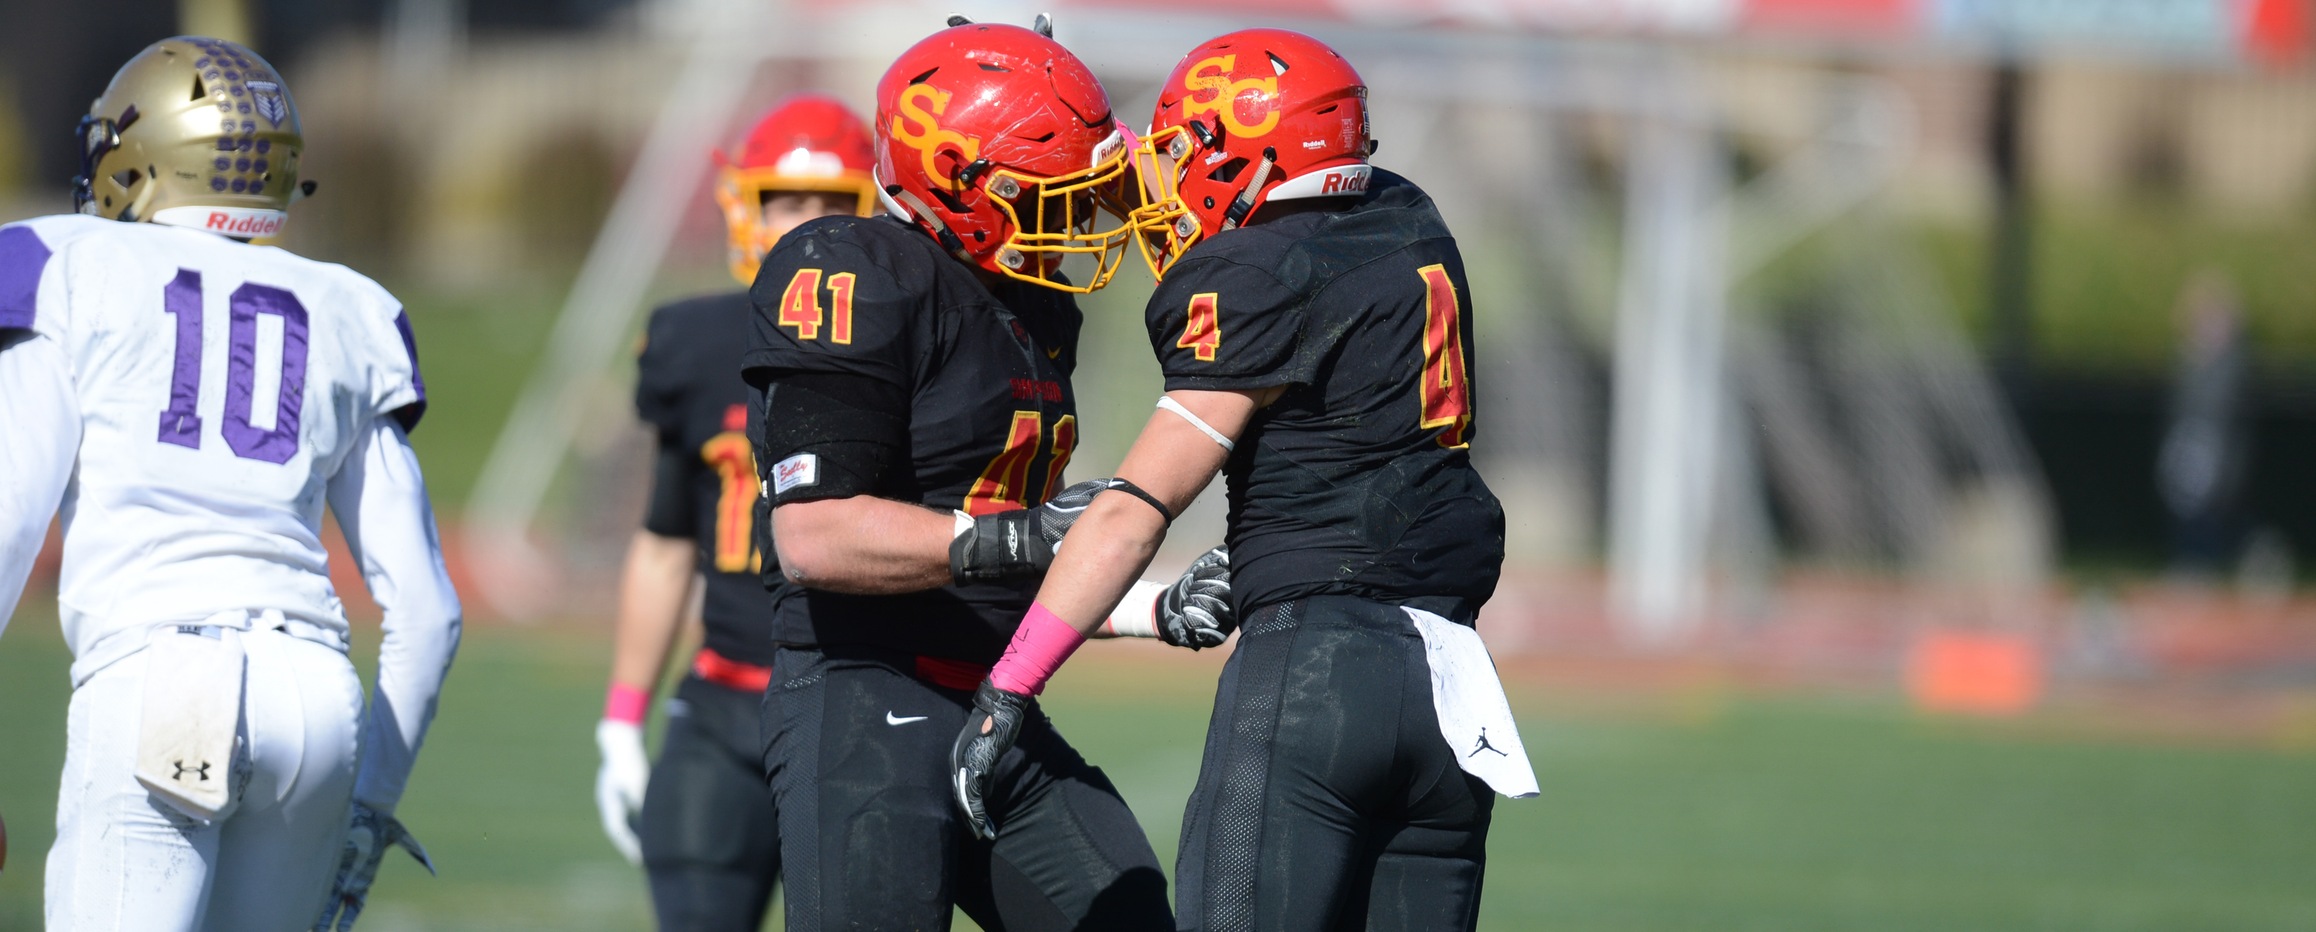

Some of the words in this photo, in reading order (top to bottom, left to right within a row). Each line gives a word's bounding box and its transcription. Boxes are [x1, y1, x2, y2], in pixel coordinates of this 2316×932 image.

[892, 83, 981, 191] SC
[1183, 54, 1281, 138] SC
[206, 212, 286, 233] Riddel
[1322, 170, 1371, 194] Ridde
[779, 268, 856, 345] 41
[1176, 292, 1221, 361] 4
[158, 267, 309, 465] 10
[1417, 263, 1471, 449] 4
[701, 430, 762, 574] 1
[963, 410, 1075, 516] 41
